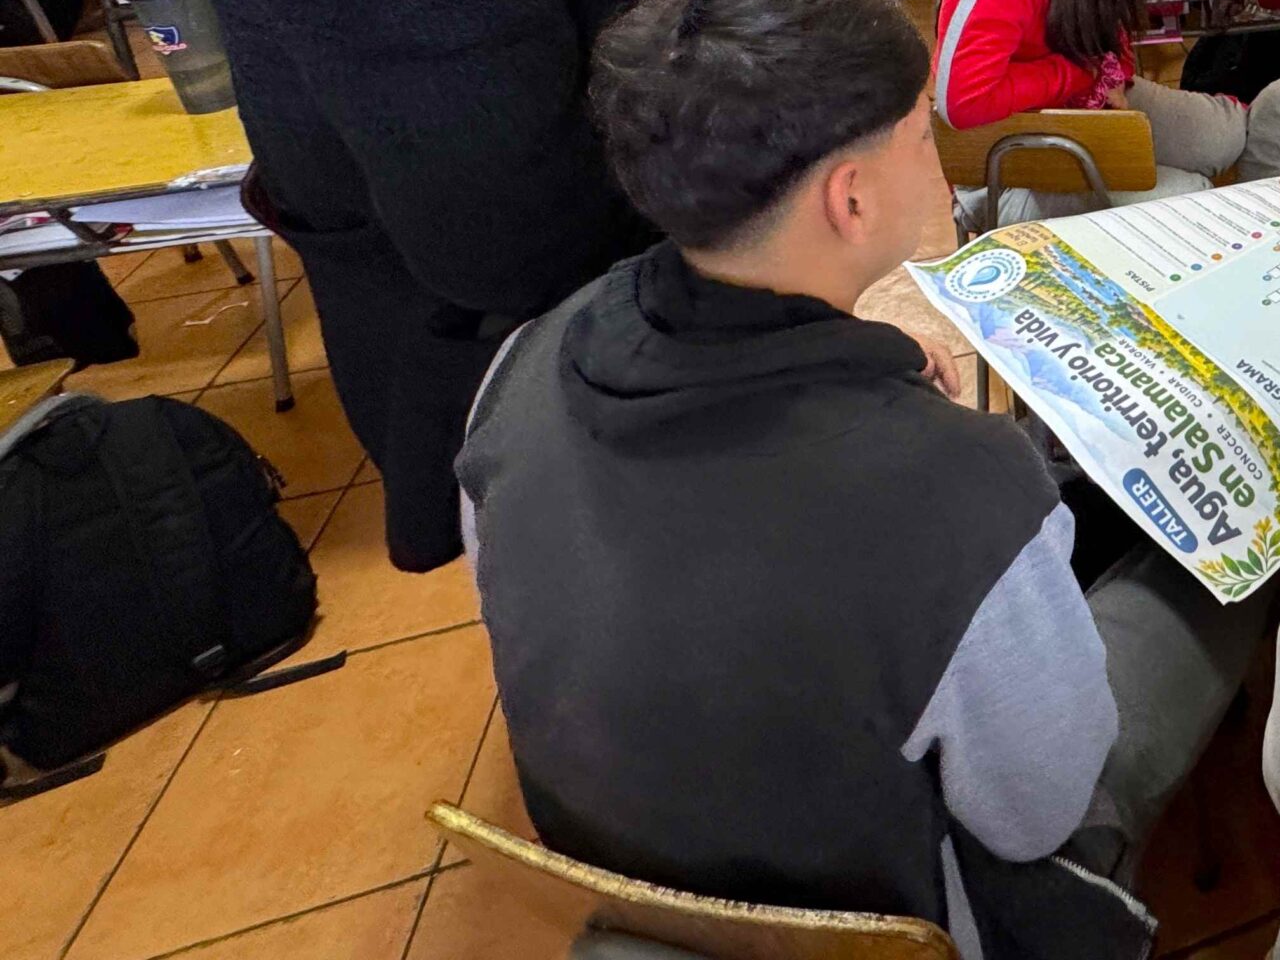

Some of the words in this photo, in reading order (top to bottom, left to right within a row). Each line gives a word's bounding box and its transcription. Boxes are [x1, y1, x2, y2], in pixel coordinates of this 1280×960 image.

[1125, 270, 1156, 293] PISTAS
[1014, 308, 1059, 348] vida
[1051, 341, 1082, 360] y
[1118, 338, 1157, 370] VALORAR
[1067, 355, 1168, 459] territorio
[1094, 342, 1225, 474] Salamanca
[1168, 376, 1203, 408] CUIDAR
[1216, 424, 1263, 481] CONOCER
[1168, 448, 1242, 546] Agua,
[1218, 464, 1255, 508] en
[1132, 476, 1187, 546] TALLER
